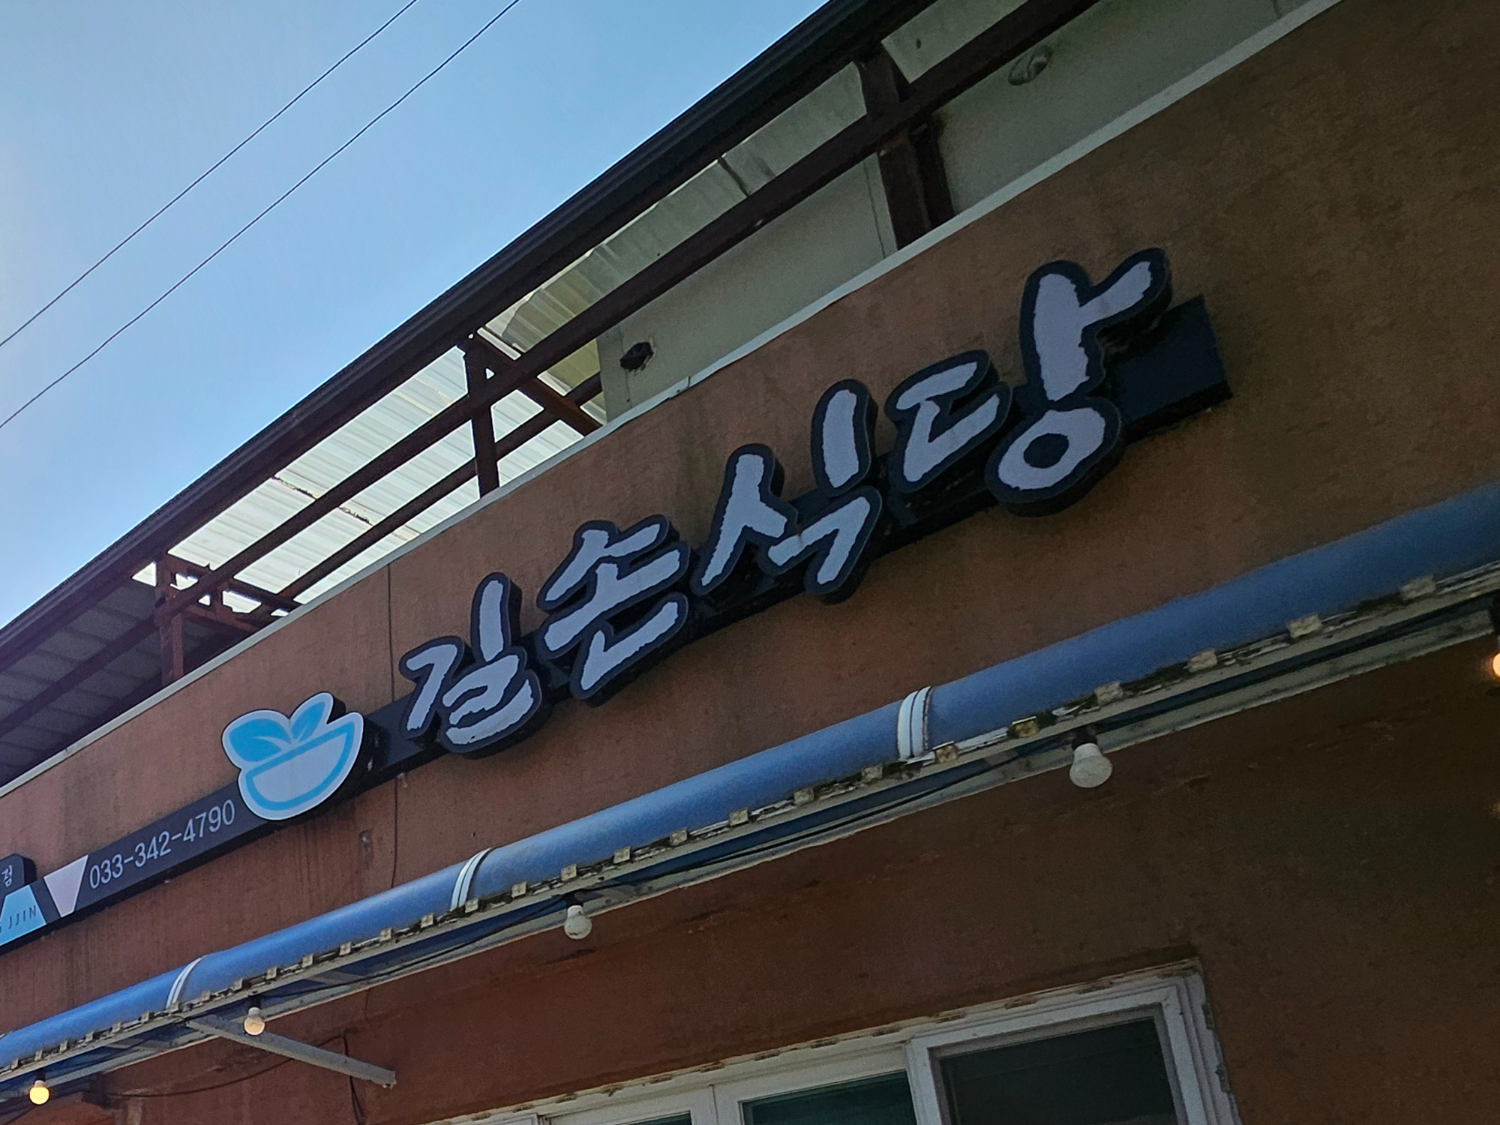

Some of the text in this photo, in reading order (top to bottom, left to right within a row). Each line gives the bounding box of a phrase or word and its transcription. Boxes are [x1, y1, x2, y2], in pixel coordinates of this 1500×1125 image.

[400, 248, 1170, 756] 길손식당
[89, 799, 235, 889] 033-342-4790
[8, 905, 36, 929] JJIN
